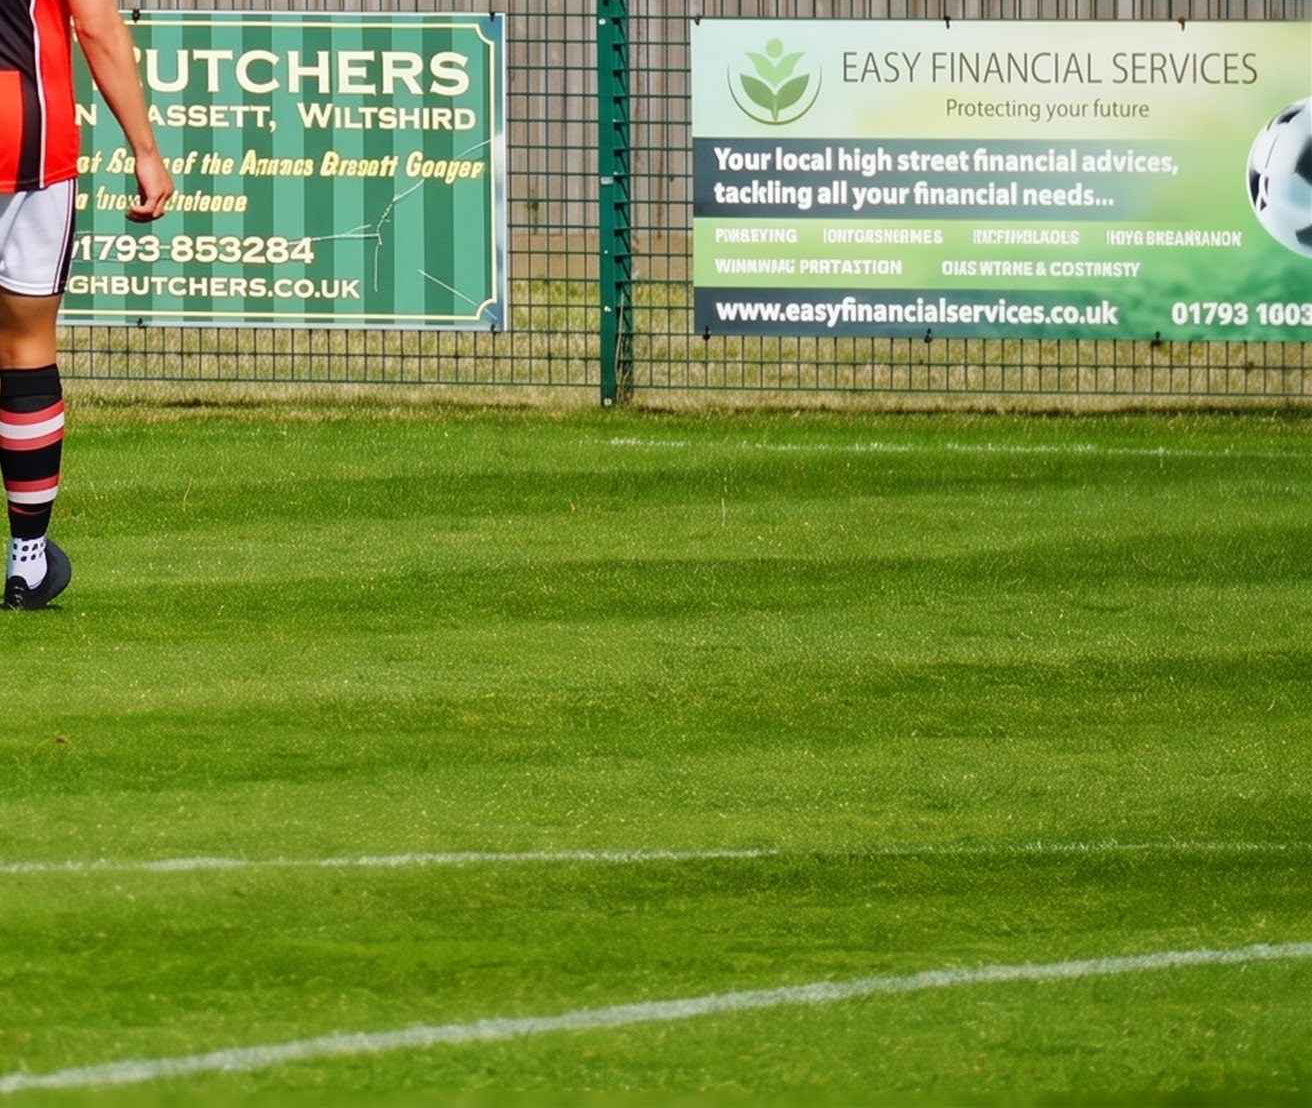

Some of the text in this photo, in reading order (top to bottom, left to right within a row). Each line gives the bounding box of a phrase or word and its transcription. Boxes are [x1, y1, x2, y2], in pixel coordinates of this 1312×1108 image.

[842, 52, 1258, 84] EASY FINANCIAL SERVICES
[147, 104, 277, 133] ASSETT,
[946, 98, 1150, 122] Protecting your future
[714, 147, 1179, 177] Your local high street financial advices,
[714, 180, 1115, 211] tackling all your financial needs...
[170, 235, 315, 264] 853284
[65, 275, 361, 299] GHBUTCHERS.CO.UK
[715, 297, 1119, 328] www.easyfinancialservices.co.uk
[1171, 302, 1249, 326] 01793
